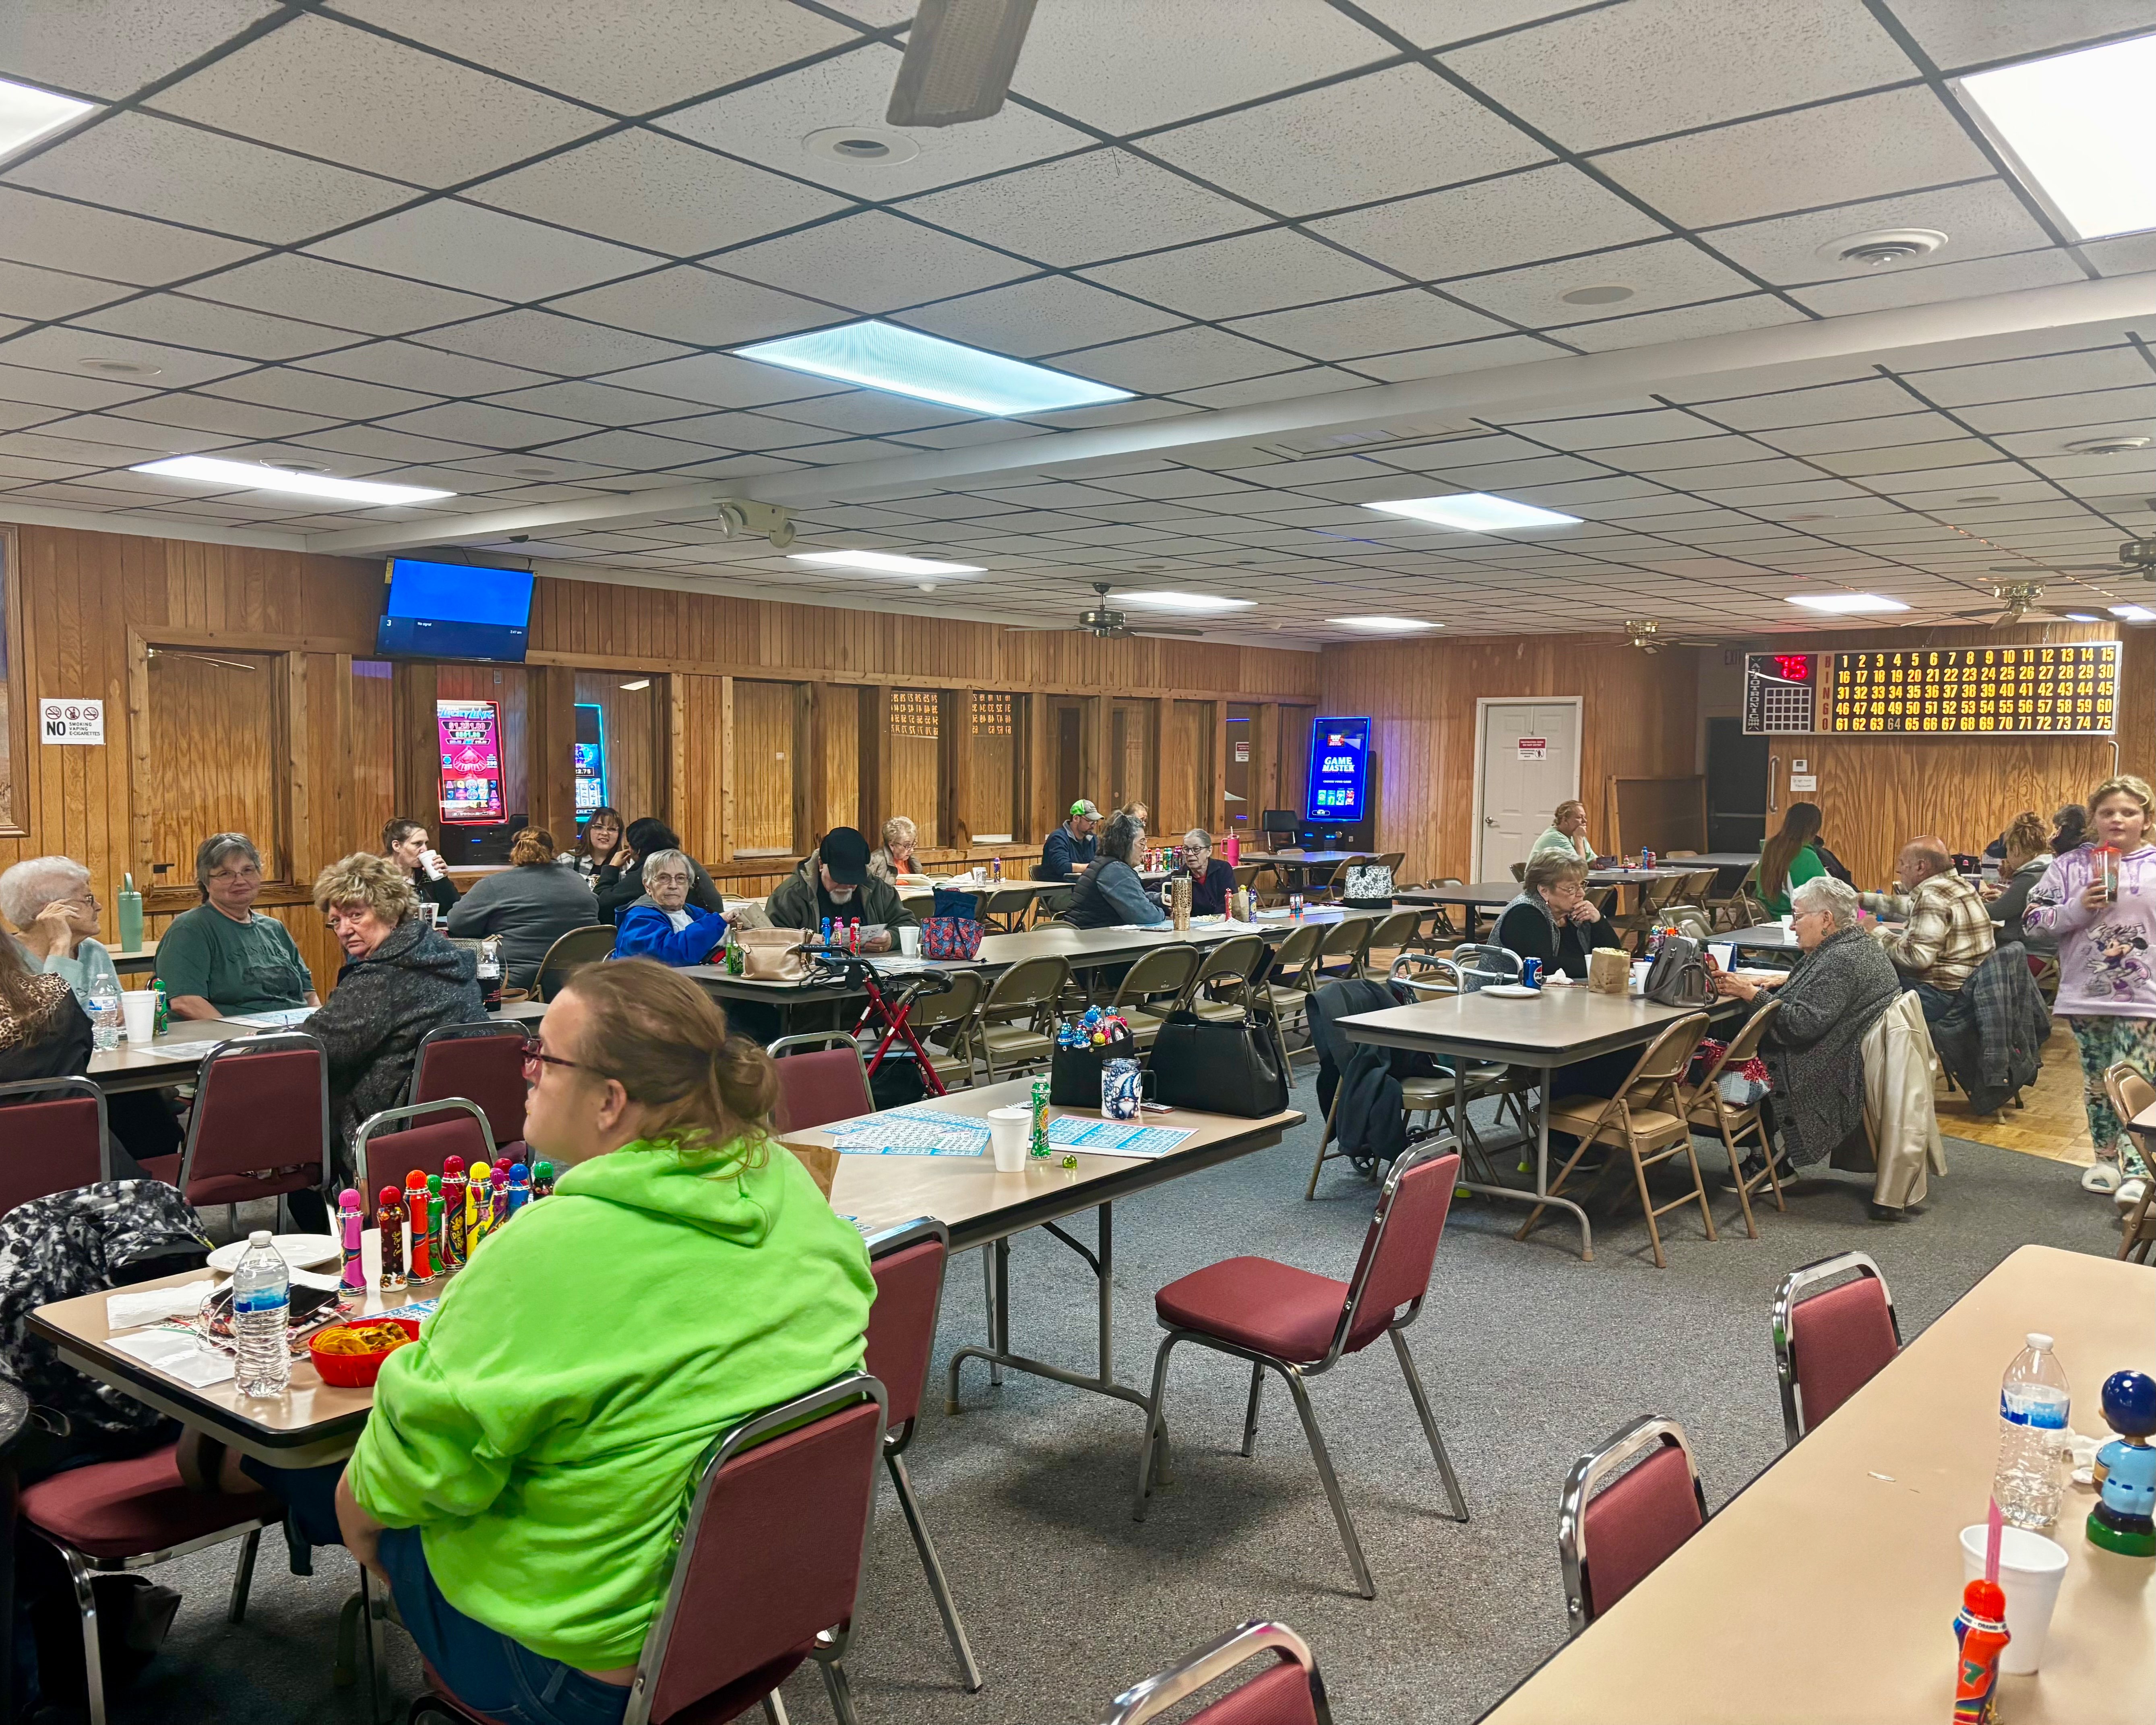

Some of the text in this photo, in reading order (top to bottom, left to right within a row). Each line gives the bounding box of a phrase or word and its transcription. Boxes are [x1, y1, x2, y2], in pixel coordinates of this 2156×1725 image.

[1842, 647, 2115, 668] 1 2 3 4 5 6 7 8 9 10 11 12 13 14 15
[1774, 655, 1808, 680] 75
[1838, 664, 2114, 684] 16 17 18 19 20 21 22 23 24 25 26 27 28 29 30
[1837, 681, 2113, 699] 31 32 33 34 35 36 37 38 39 40 41 42 43 44 45
[1836, 698, 2112, 715] 46 47 48 49 50 51 52 53 54 55 56 57 58 59 60
[47, 722, 66, 735] NO
[1836, 716, 2111, 731] 61 62 63 64 65 66 67 68 69 70 71 72 73 74 75
[1324, 757, 1352, 765] GAME
